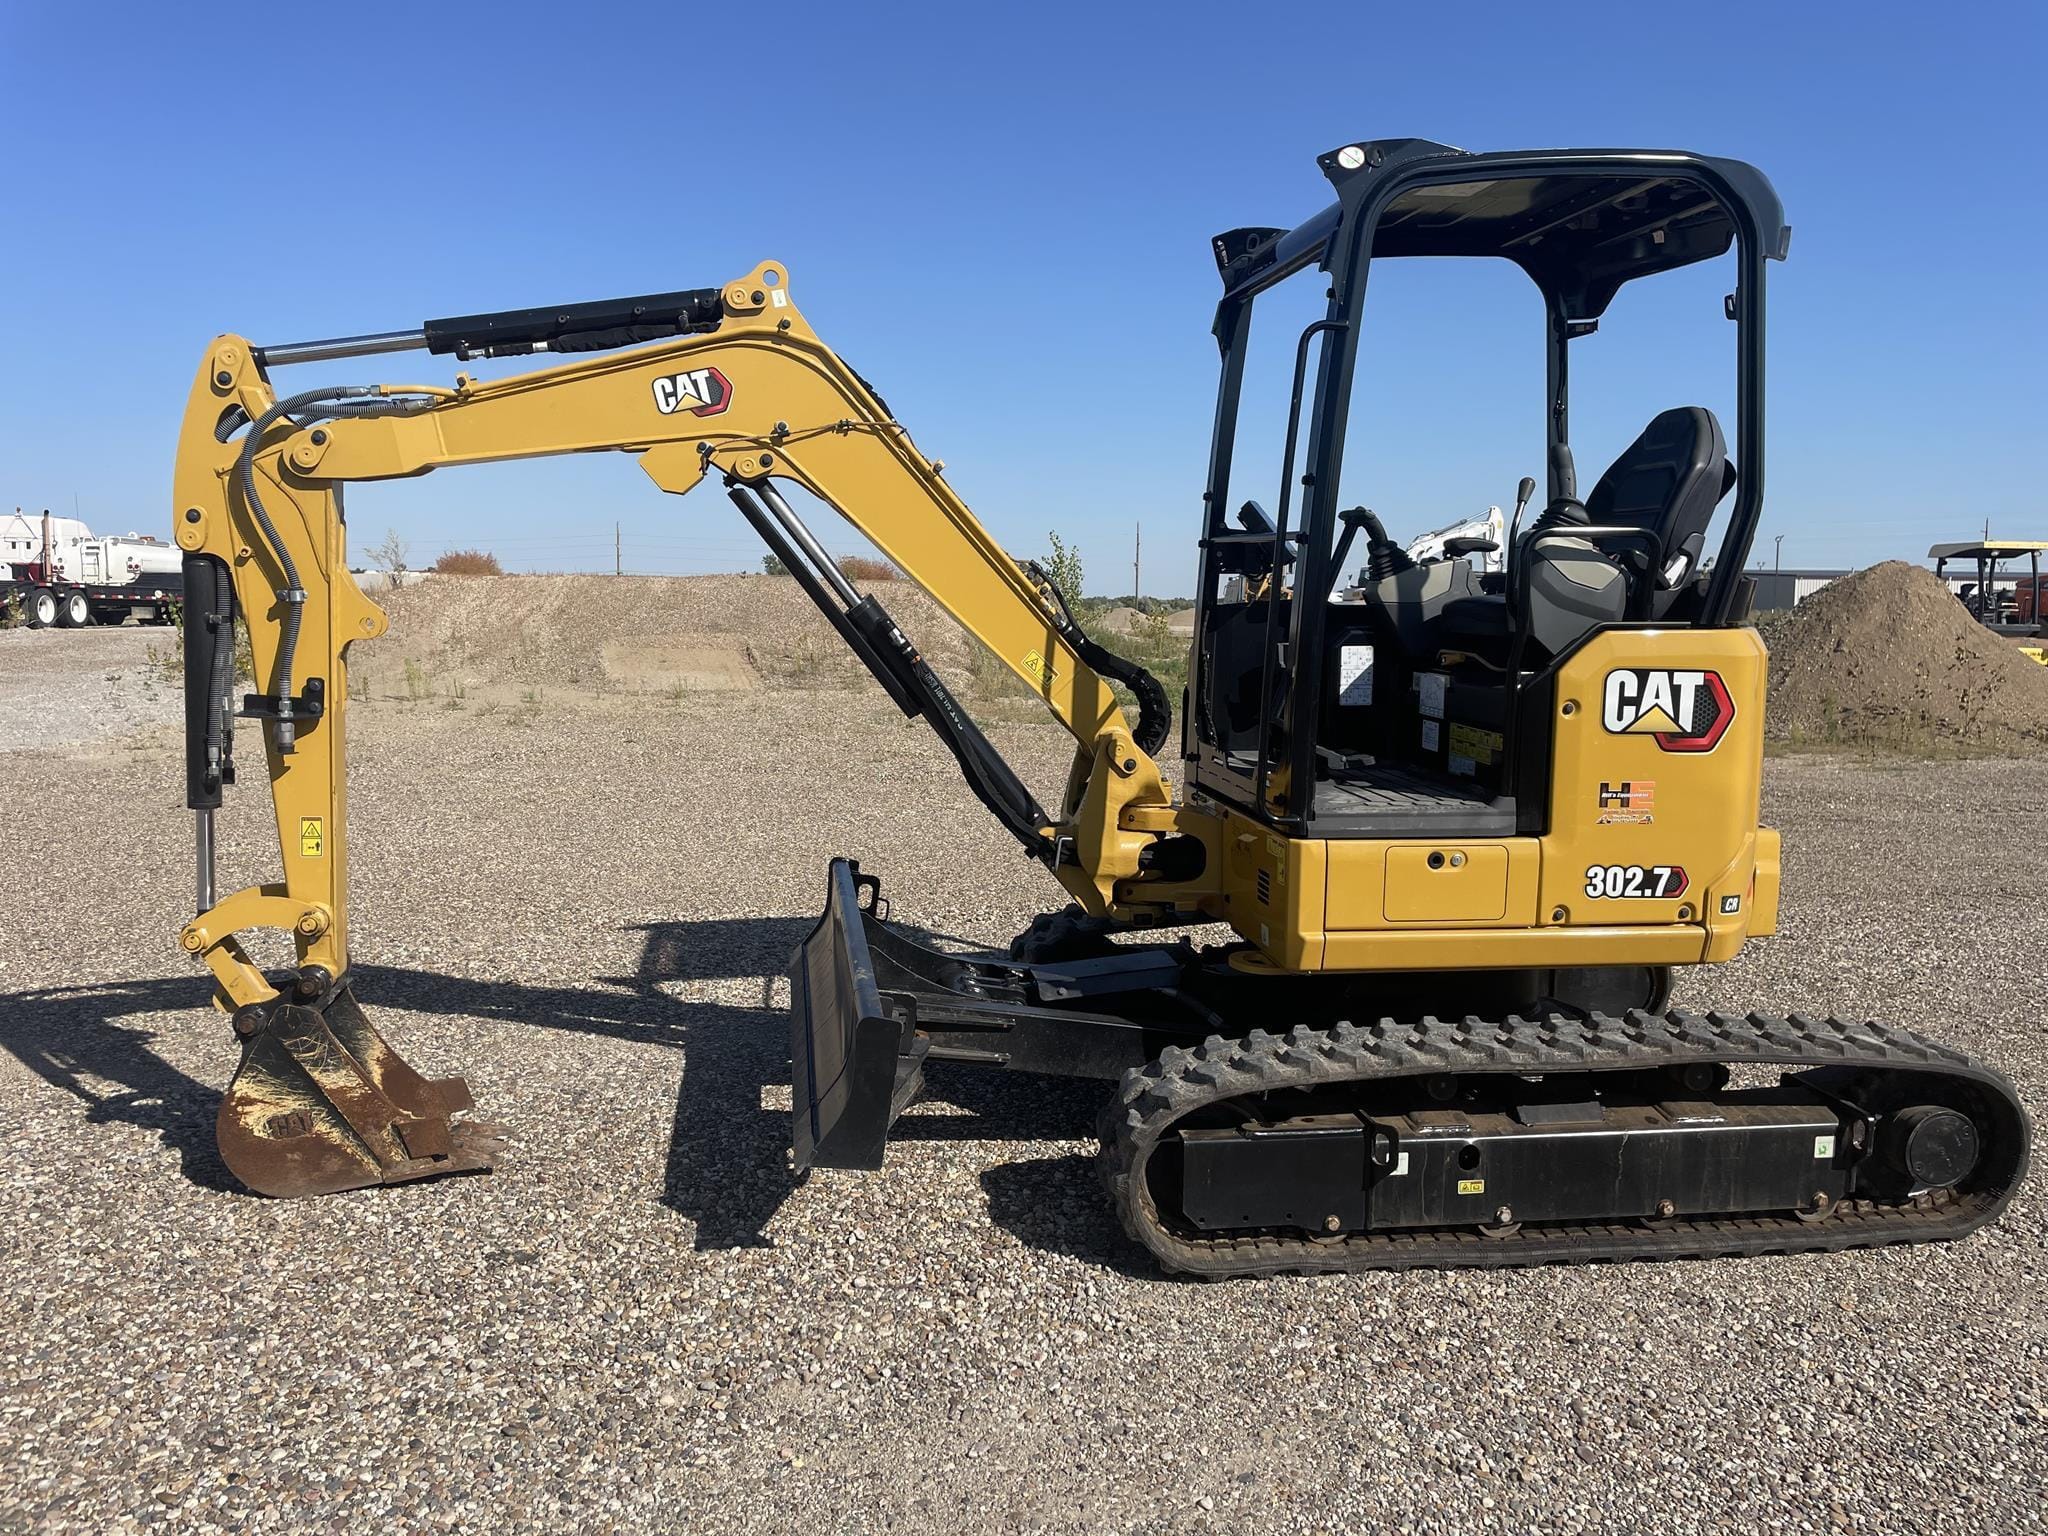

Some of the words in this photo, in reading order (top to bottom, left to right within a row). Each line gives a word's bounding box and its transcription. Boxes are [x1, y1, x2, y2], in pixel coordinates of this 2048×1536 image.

[653, 369, 711, 414] CAT
[1604, 669, 1705, 733] CAT
[1586, 865, 1672, 897] 302.7
[1725, 897, 1739, 911] CR
